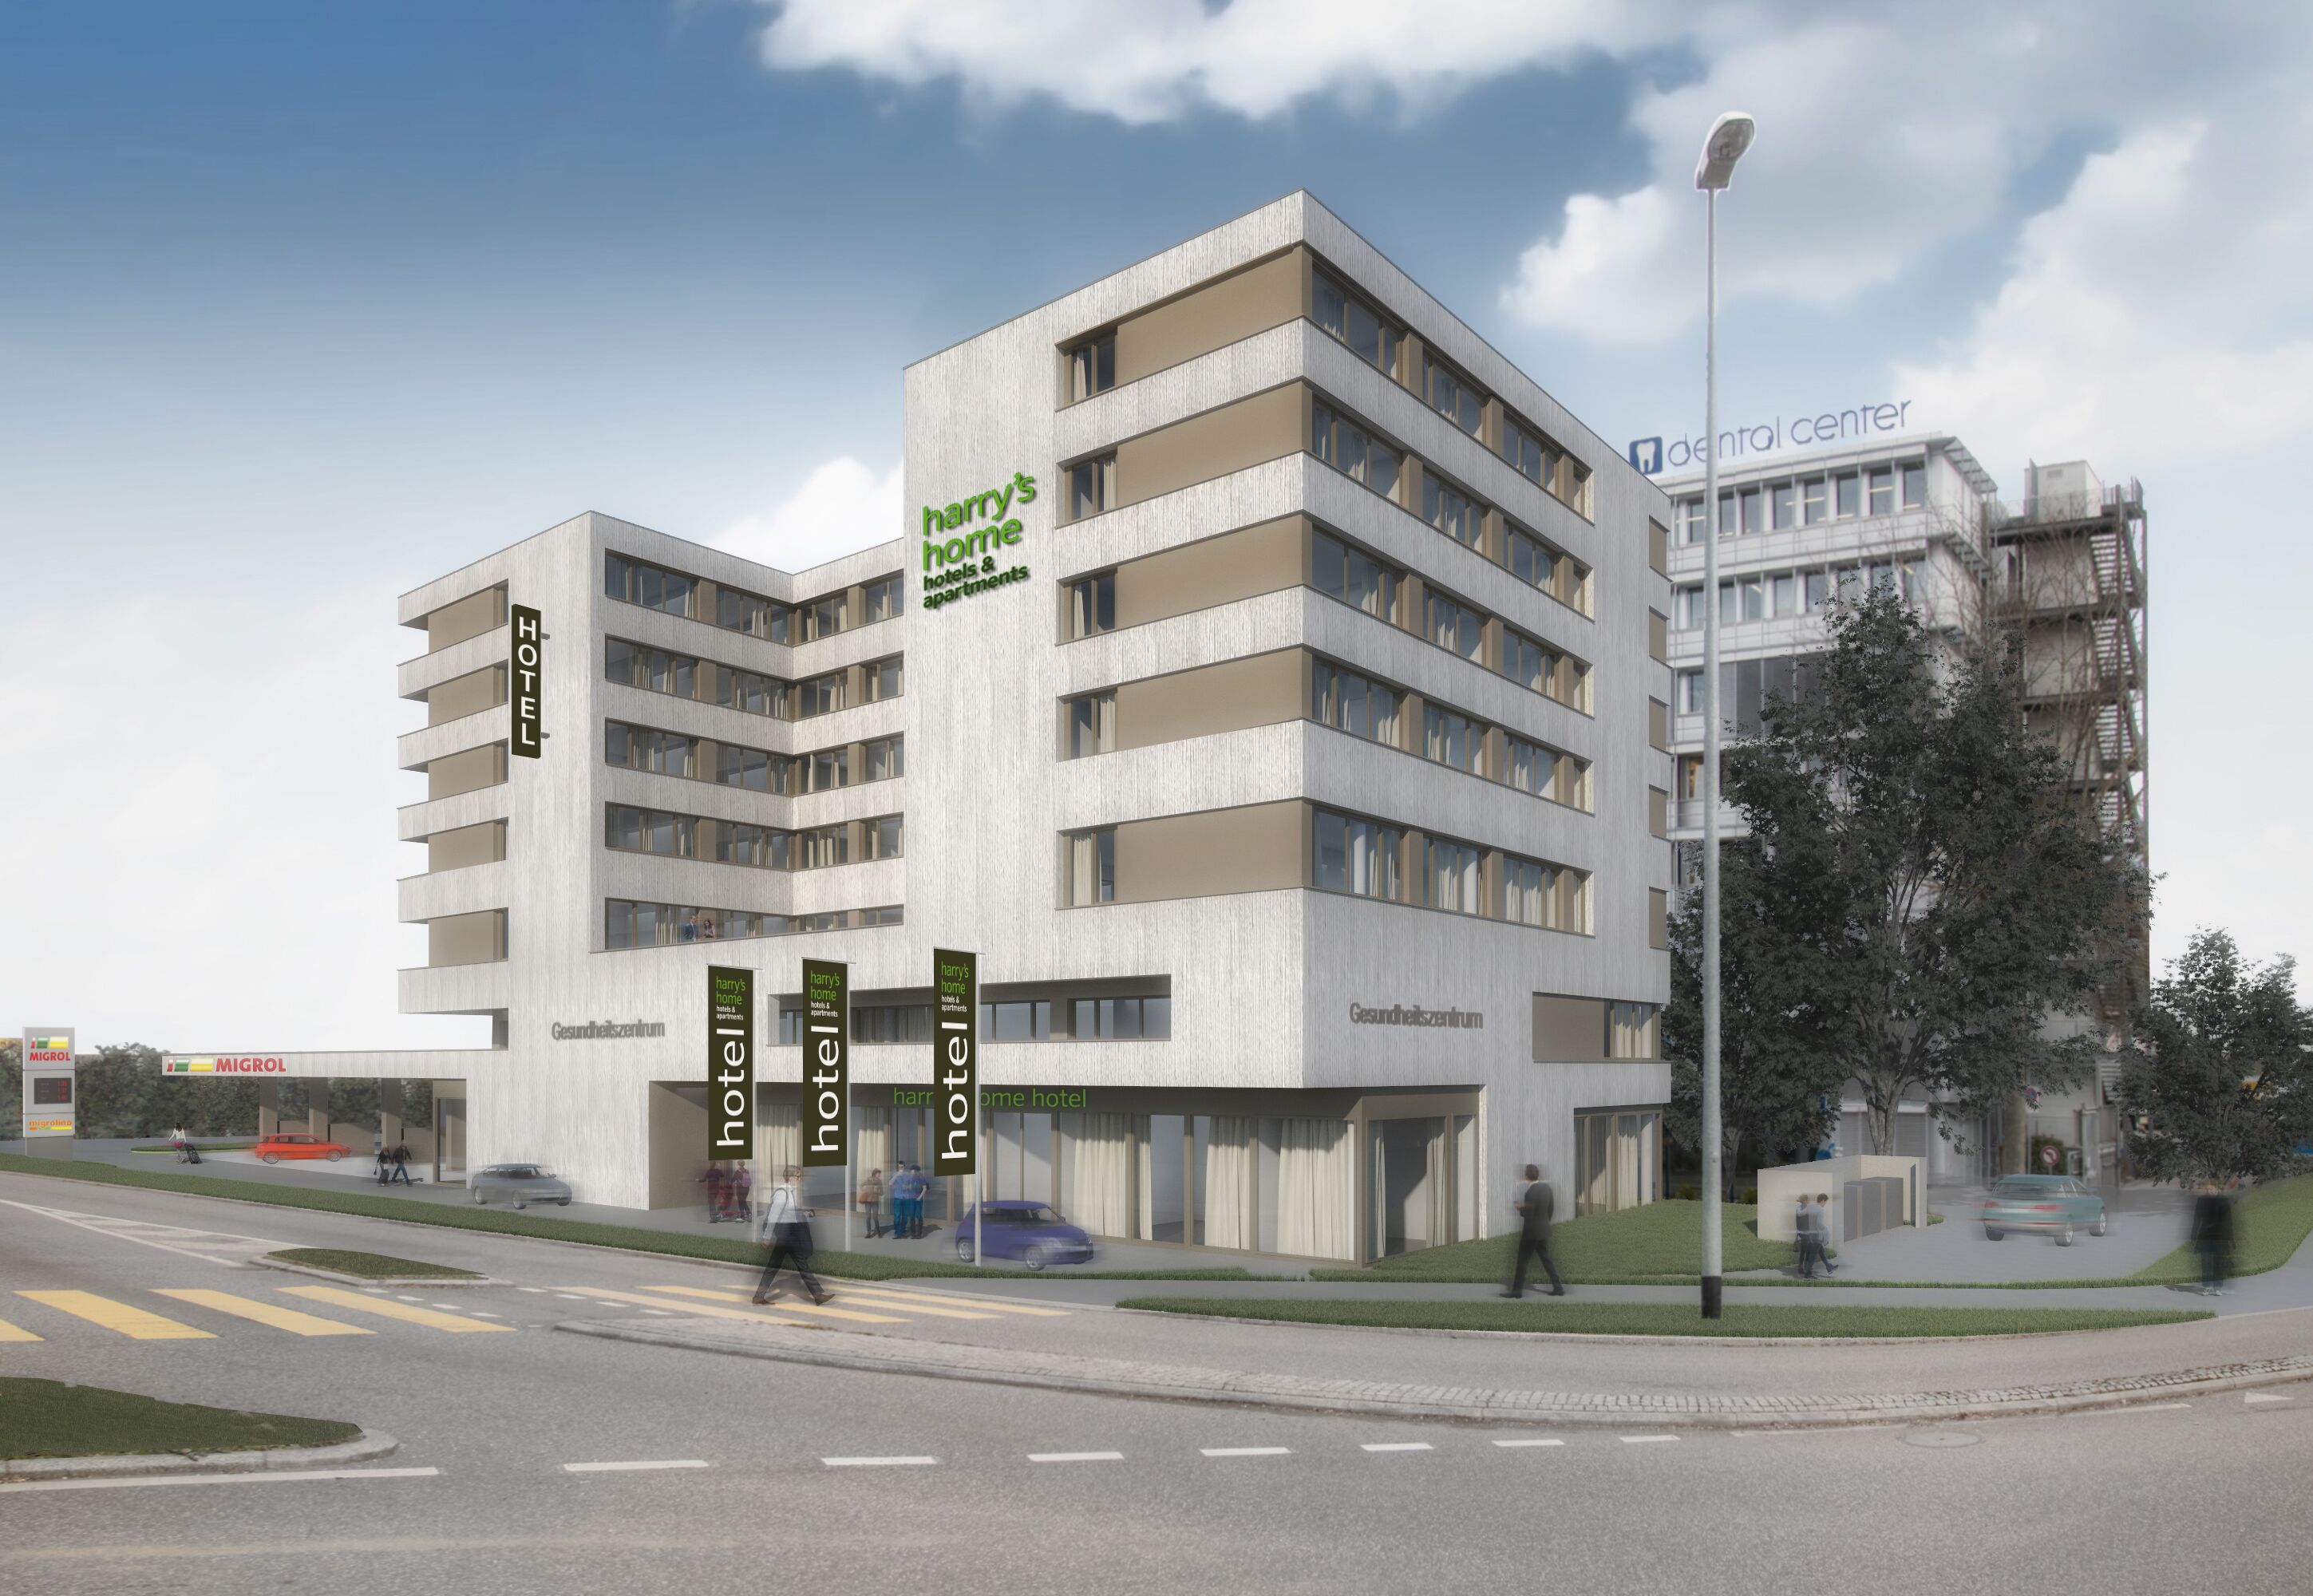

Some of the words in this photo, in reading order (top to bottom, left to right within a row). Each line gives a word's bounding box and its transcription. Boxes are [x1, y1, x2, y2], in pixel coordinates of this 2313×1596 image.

[1668, 416, 1781, 466] dental
[1791, 400, 1912, 444] center
[923, 472, 1036, 535] harry's
[923, 518, 1022, 571] home
[923, 563, 977, 591] hotels
[981, 556, 995, 573] &
[923, 566, 1029, 609] apartments
[518, 616, 537, 745] HOTEL
[810, 970, 840, 989] harry's
[941, 960, 969, 981] harry's
[716, 976, 745, 994] harry's
[810, 986, 836, 1001] home
[941, 978, 966, 994] home
[716, 990, 742, 1005] home
[810, 1000, 826, 1009] hotels
[941, 994, 955, 1003] hotels
[941, 1004, 967, 1013] apartments
[30, 1052, 71, 1061] MIGROL
[215, 1058, 287, 1073] MIGROL
[716, 1028, 745, 1146] hotel
[811, 1025, 839, 1151] hotel
[893, 1087, 934, 1105] harr
[980, 1090, 1026, 1107] ome
[1032, 1088, 1086, 1108] hotel
[941, 1021, 968, 1159] hotel
